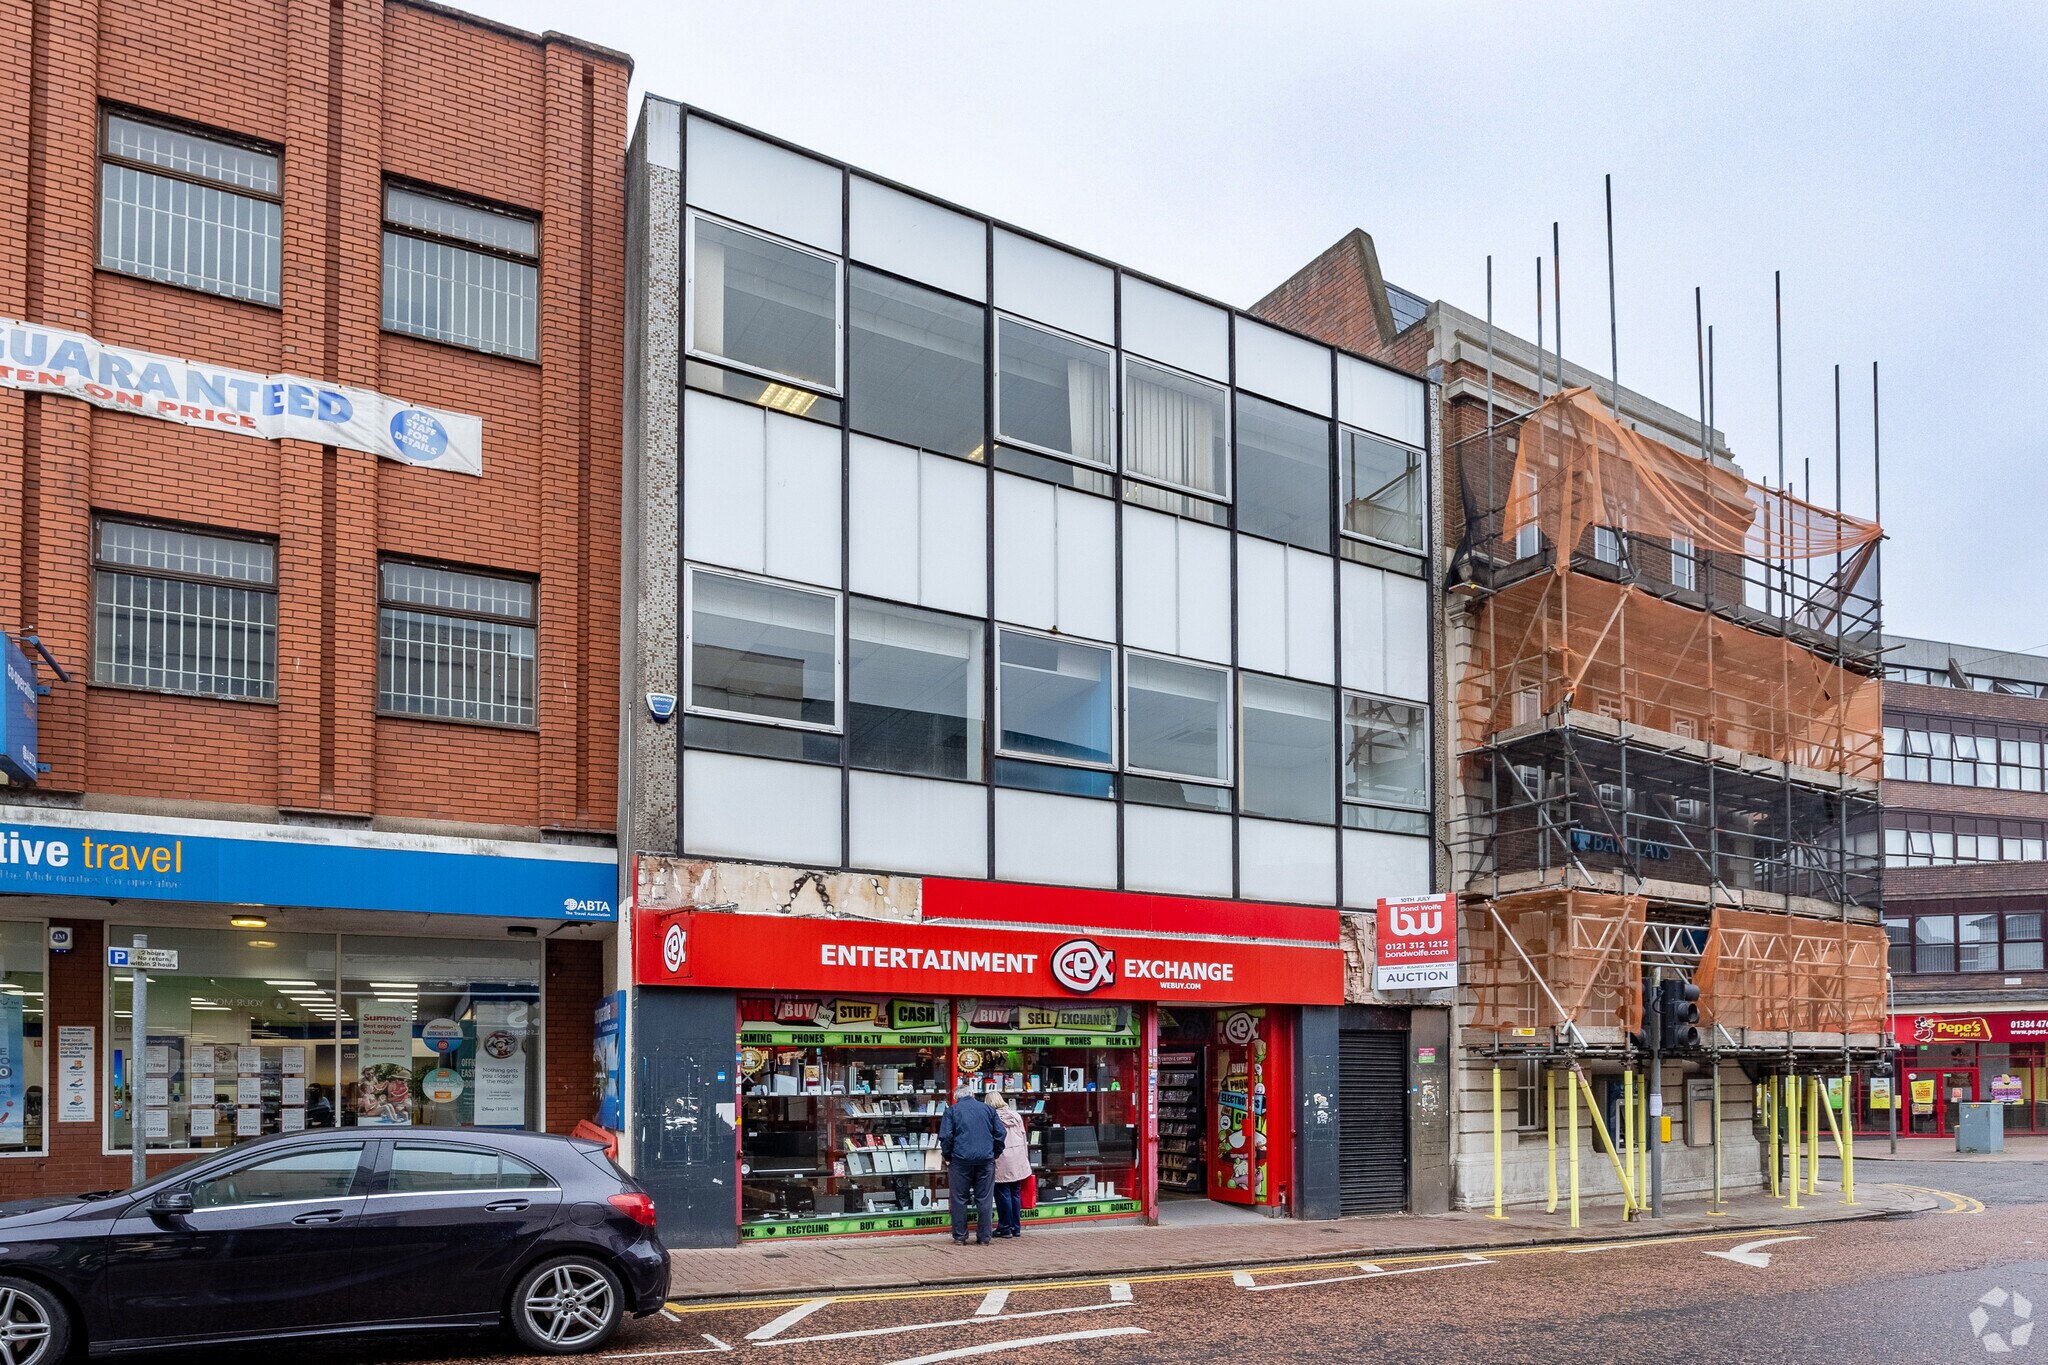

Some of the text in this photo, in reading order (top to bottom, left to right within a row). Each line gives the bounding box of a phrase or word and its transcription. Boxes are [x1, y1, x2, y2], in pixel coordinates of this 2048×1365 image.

[0, 327, 353, 424] UARANTEED
[84, 383, 143, 407] ON
[157, 400, 257, 429] PRICE
[405, 418, 437, 436] STAFF
[411, 413, 434, 427] ASK
[394, 430, 437, 455] DETAILS
[407, 428, 429, 443] FOR
[82, 836, 182, 873] travel
[577, 900, 611, 912] ABTA
[1428, 940, 1448, 948] 1212
[114, 951, 126, 963] P
[821, 944, 1038, 974] ENTERTAINMENT
[1385, 949, 1449, 958] bondwolfe.com
[1124, 958, 1234, 981] EXCHANGE
[1386, 971, 1449, 983] AUCTION
[1159, 982, 1202, 990] WEBUY.COM
[784, 1003, 812, 1018] BUY
[840, 1006, 872, 1018] STUFF
[900, 1006, 935, 1022] CASH
[980, 1005, 1004, 1022] BUY
[363, 1014, 409, 1022] Summer.
[1028, 1013, 1051, 1025] SELL
[1061, 1012, 1112, 1026] EXCHANGE
[2010, 1020, 2035, 1028] 01384
[1937, 1021, 1981, 1035] Pepe's
[792, 1034, 825, 1043] PHONES
[844, 1034, 862, 1043] FILM
[864, 1034, 869, 1043] &
[872, 1034, 882, 1043] TV
[900, 1035, 944, 1044] COMPUTING
[960, 1036, 1008, 1045] ELECTRONICS
[1022, 1037, 1050, 1046] GAMING
[1065, 1037, 1091, 1045] PHONES
[1106, 1037, 1120, 1045] FILM
[1231, 1063, 1245, 1073] BUY
[1020, 1208, 1039, 1218] CLING
[1110, 1203, 1134, 1211] DONATE
[786, 1224, 829, 1234] RECYCLING
[859, 1222, 875, 1230] BUY
[887, 1219, 904, 1228] SELL
[915, 1216, 943, 1226] DONATE
